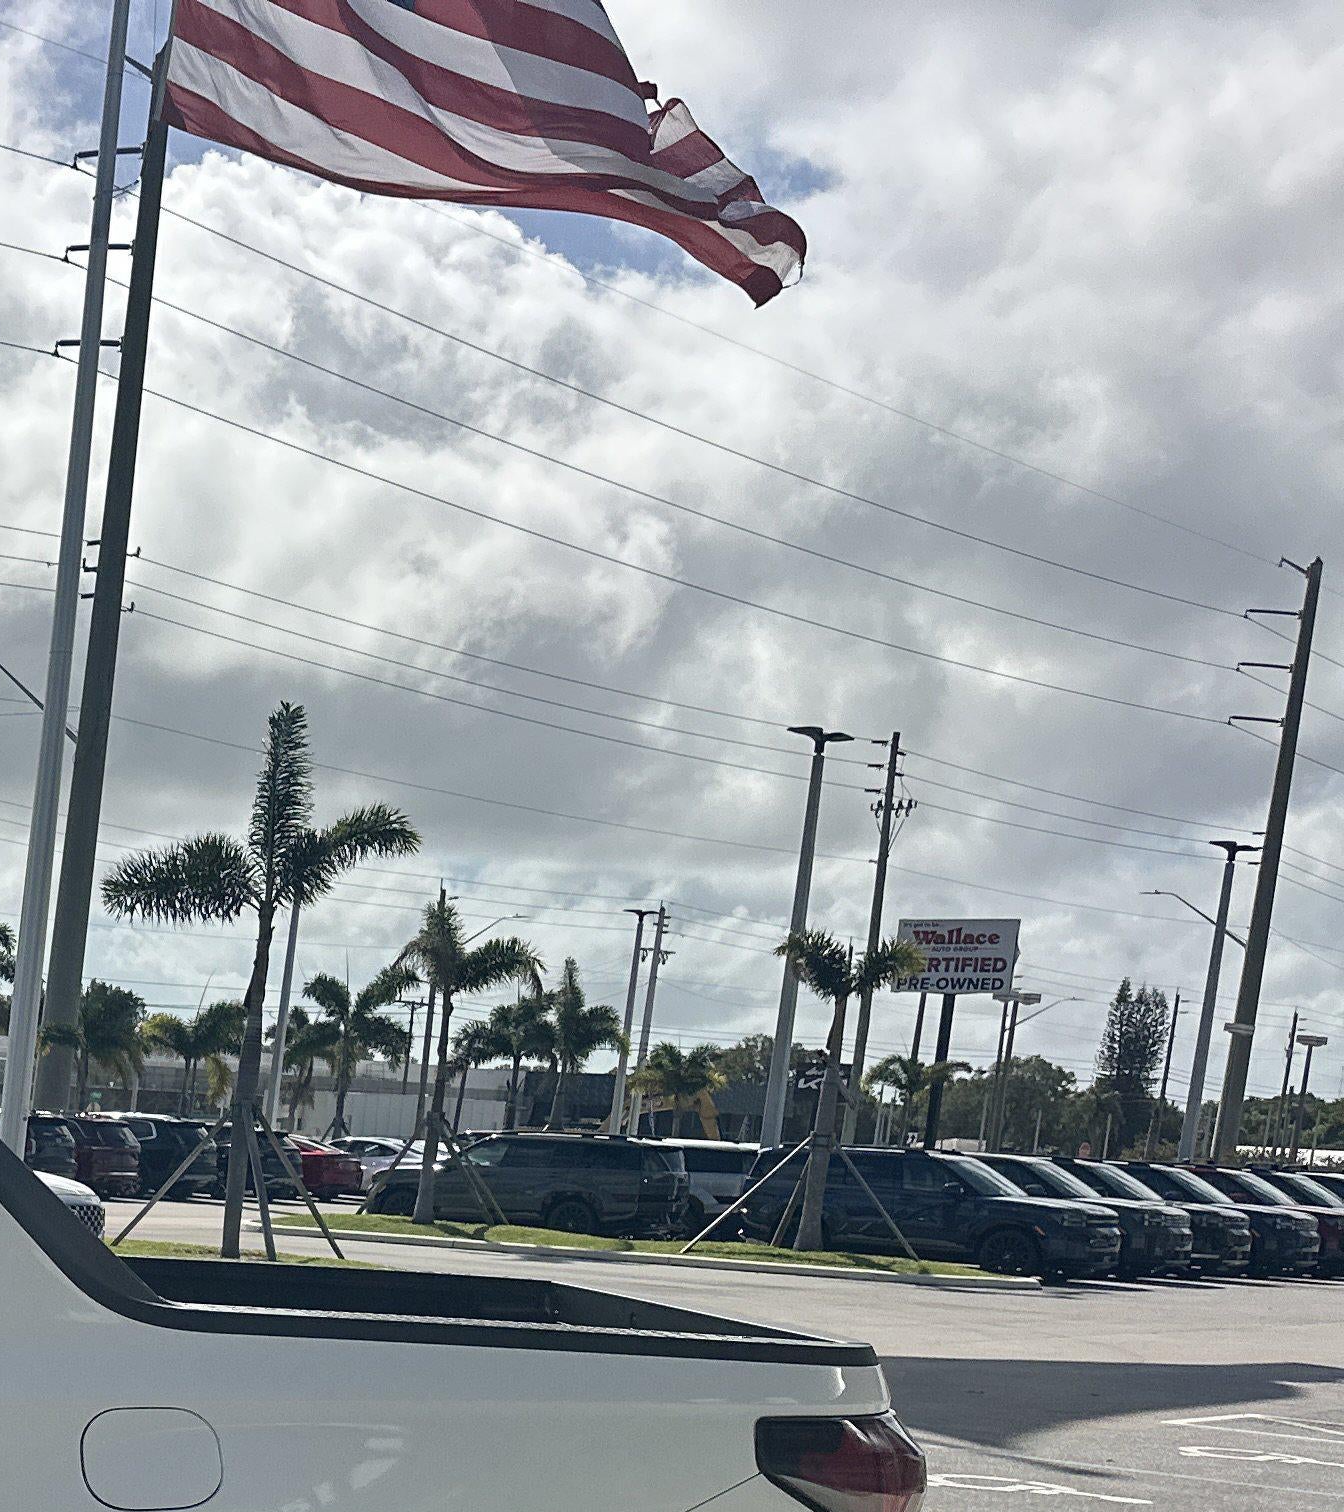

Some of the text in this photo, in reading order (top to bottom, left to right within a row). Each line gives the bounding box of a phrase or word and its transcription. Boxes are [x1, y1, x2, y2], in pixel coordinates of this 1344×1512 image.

[913, 927, 1000, 945] Wallace
[919, 957, 1008, 973] RTIFIED
[896, 976, 1005, 990] PRE-OWNED
